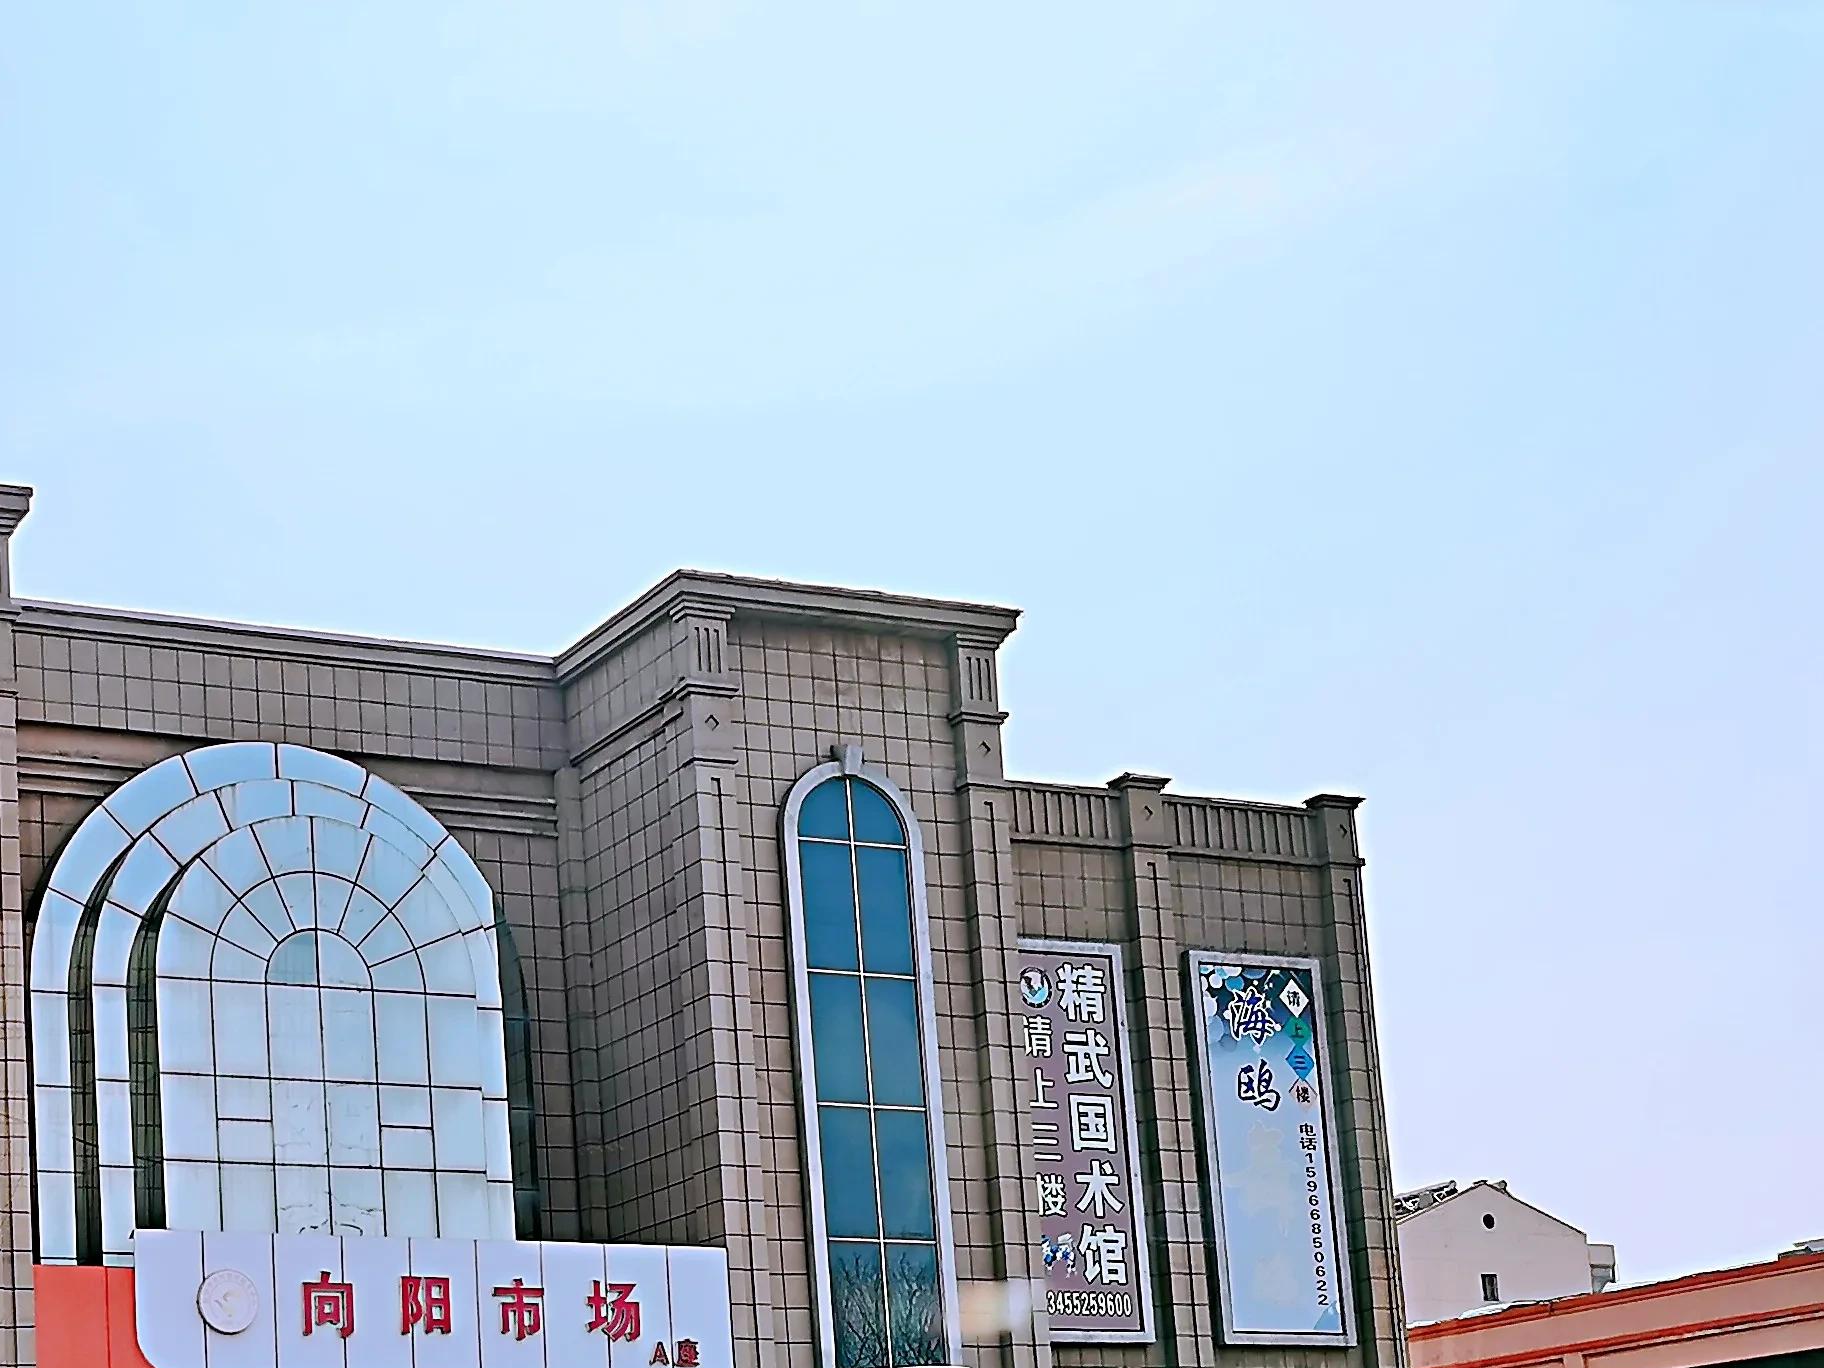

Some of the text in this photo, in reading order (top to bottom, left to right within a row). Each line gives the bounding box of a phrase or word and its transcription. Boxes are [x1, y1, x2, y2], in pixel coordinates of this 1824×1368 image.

[1228, 986, 1281, 1113] 海鸥
[1285, 988, 1313, 1105] 请上三楼
[1056, 963, 1129, 1285] 精武国术馆
[302, 1270, 642, 1342] 向阳市场
[648, 1339, 702, 1368] A座
